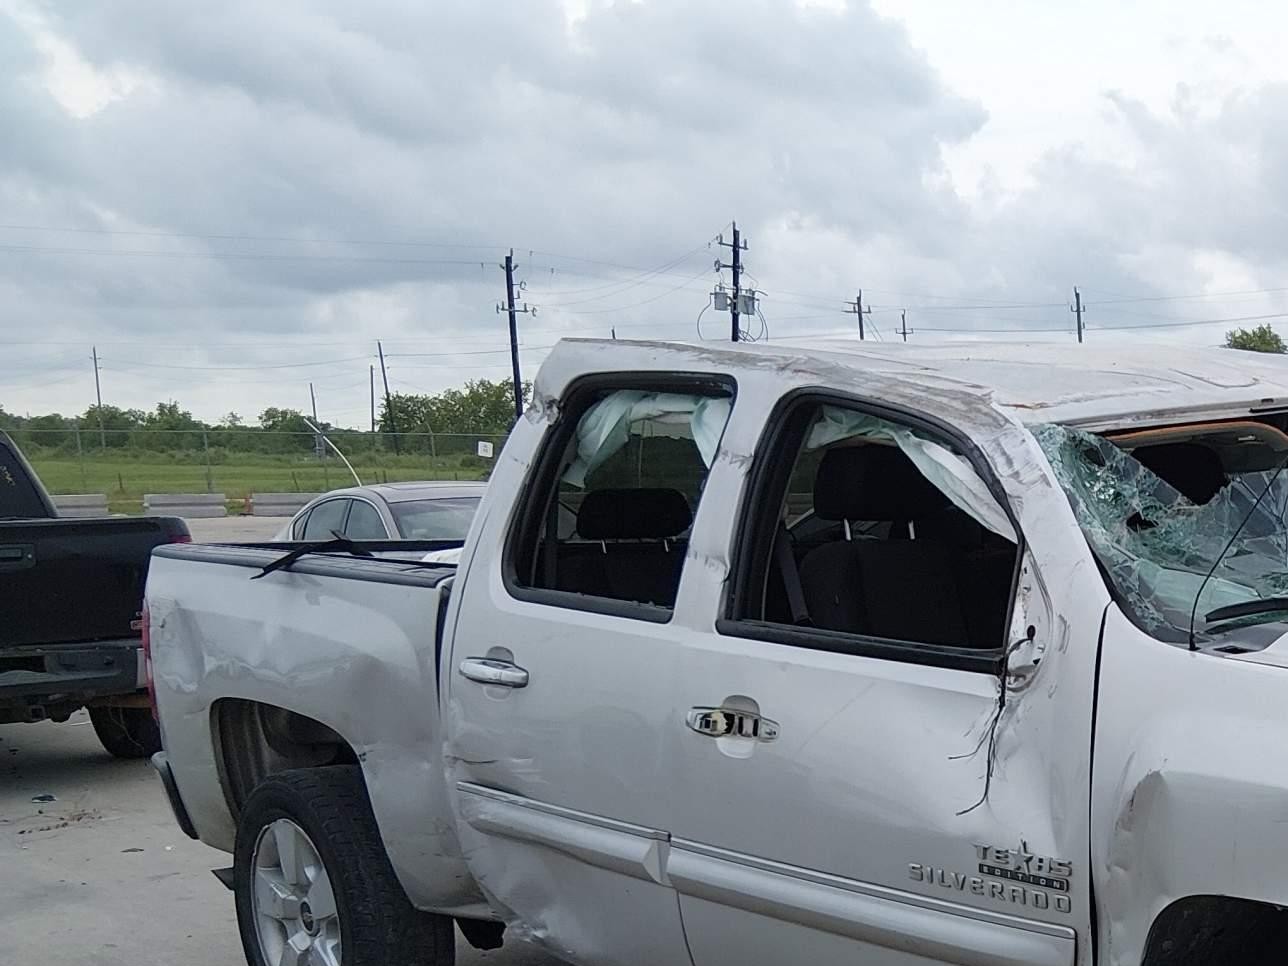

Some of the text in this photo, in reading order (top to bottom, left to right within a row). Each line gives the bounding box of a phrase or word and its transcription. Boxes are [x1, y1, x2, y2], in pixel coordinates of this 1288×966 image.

[971, 838, 1072, 876] TEXAS
[908, 862, 1071, 913] SILVERADO
[983, 865, 1062, 890] EDITION
